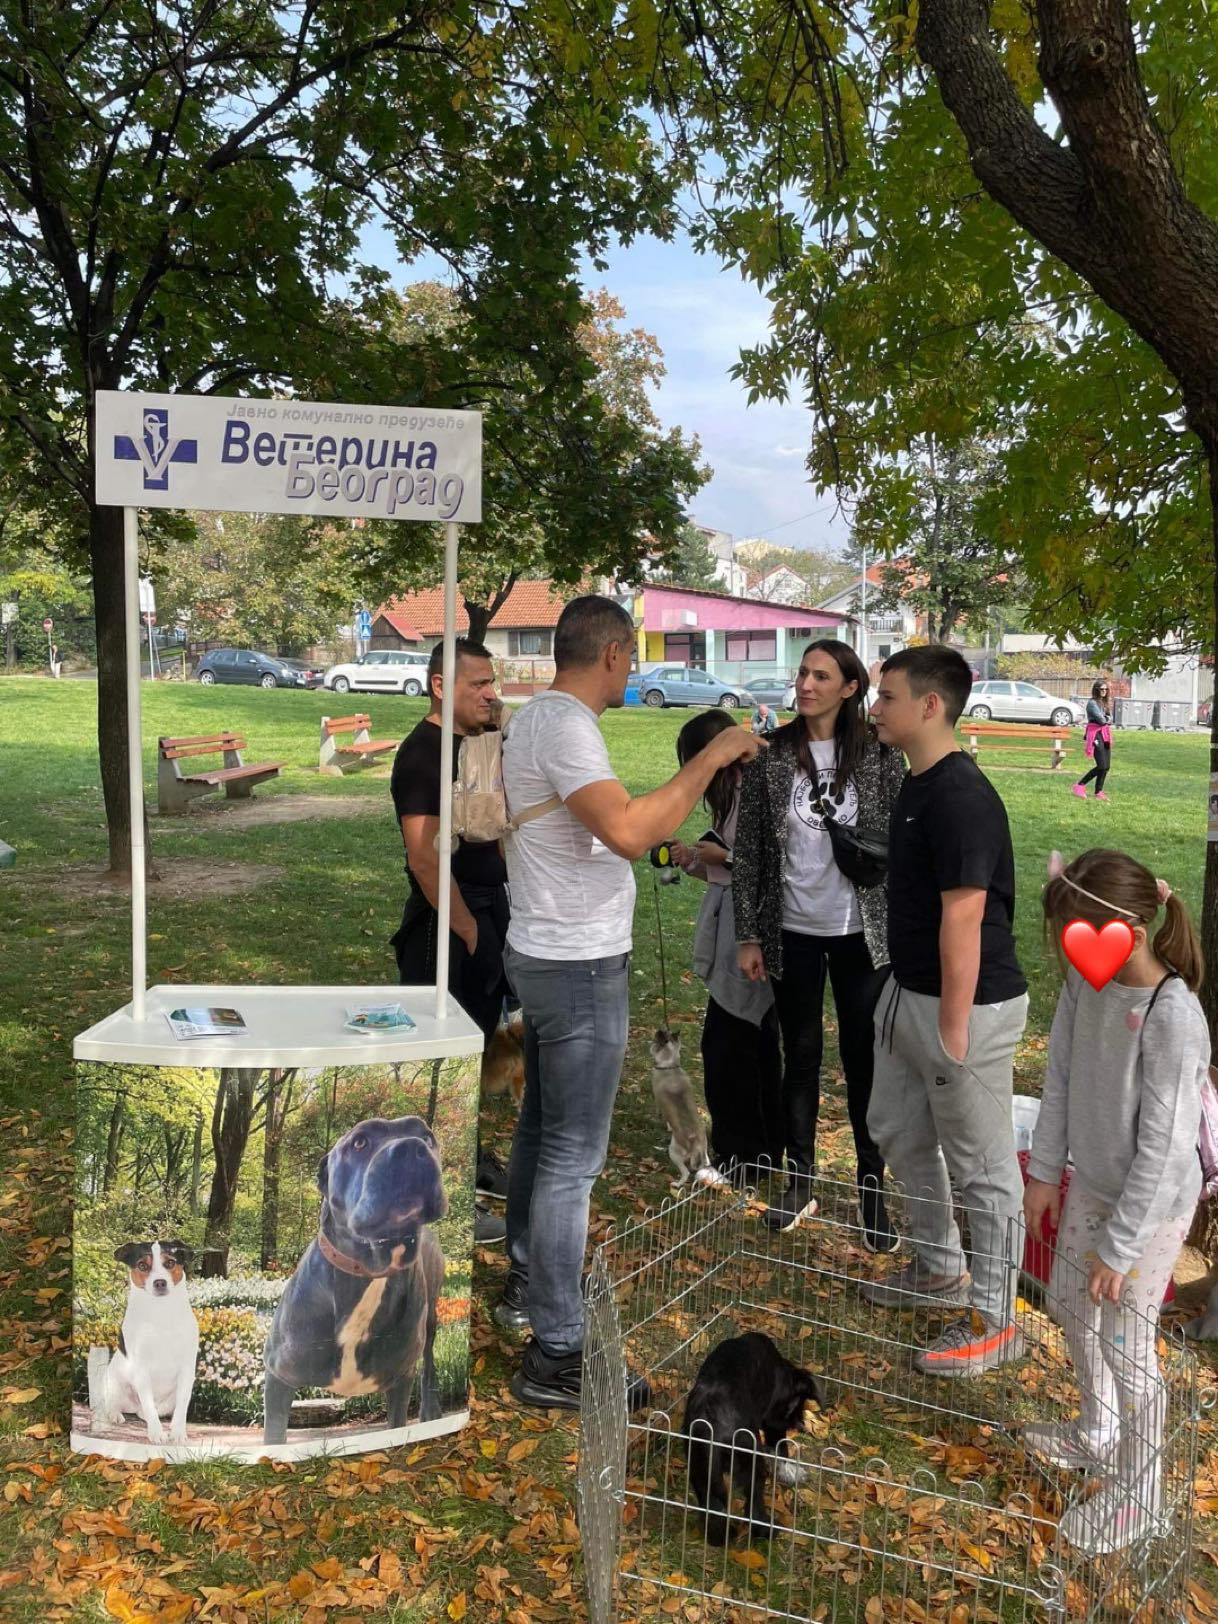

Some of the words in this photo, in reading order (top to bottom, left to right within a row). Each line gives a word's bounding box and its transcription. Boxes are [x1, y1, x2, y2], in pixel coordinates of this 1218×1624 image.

[226, 403, 277, 418] Јавно
[282, 408, 373, 425] комунално
[378, 414, 464, 431] предузеће
[221, 420, 438, 471] Ветерина
[285, 453, 464, 519] Београд
[796, 771, 824, 807] НАЈБОИ
